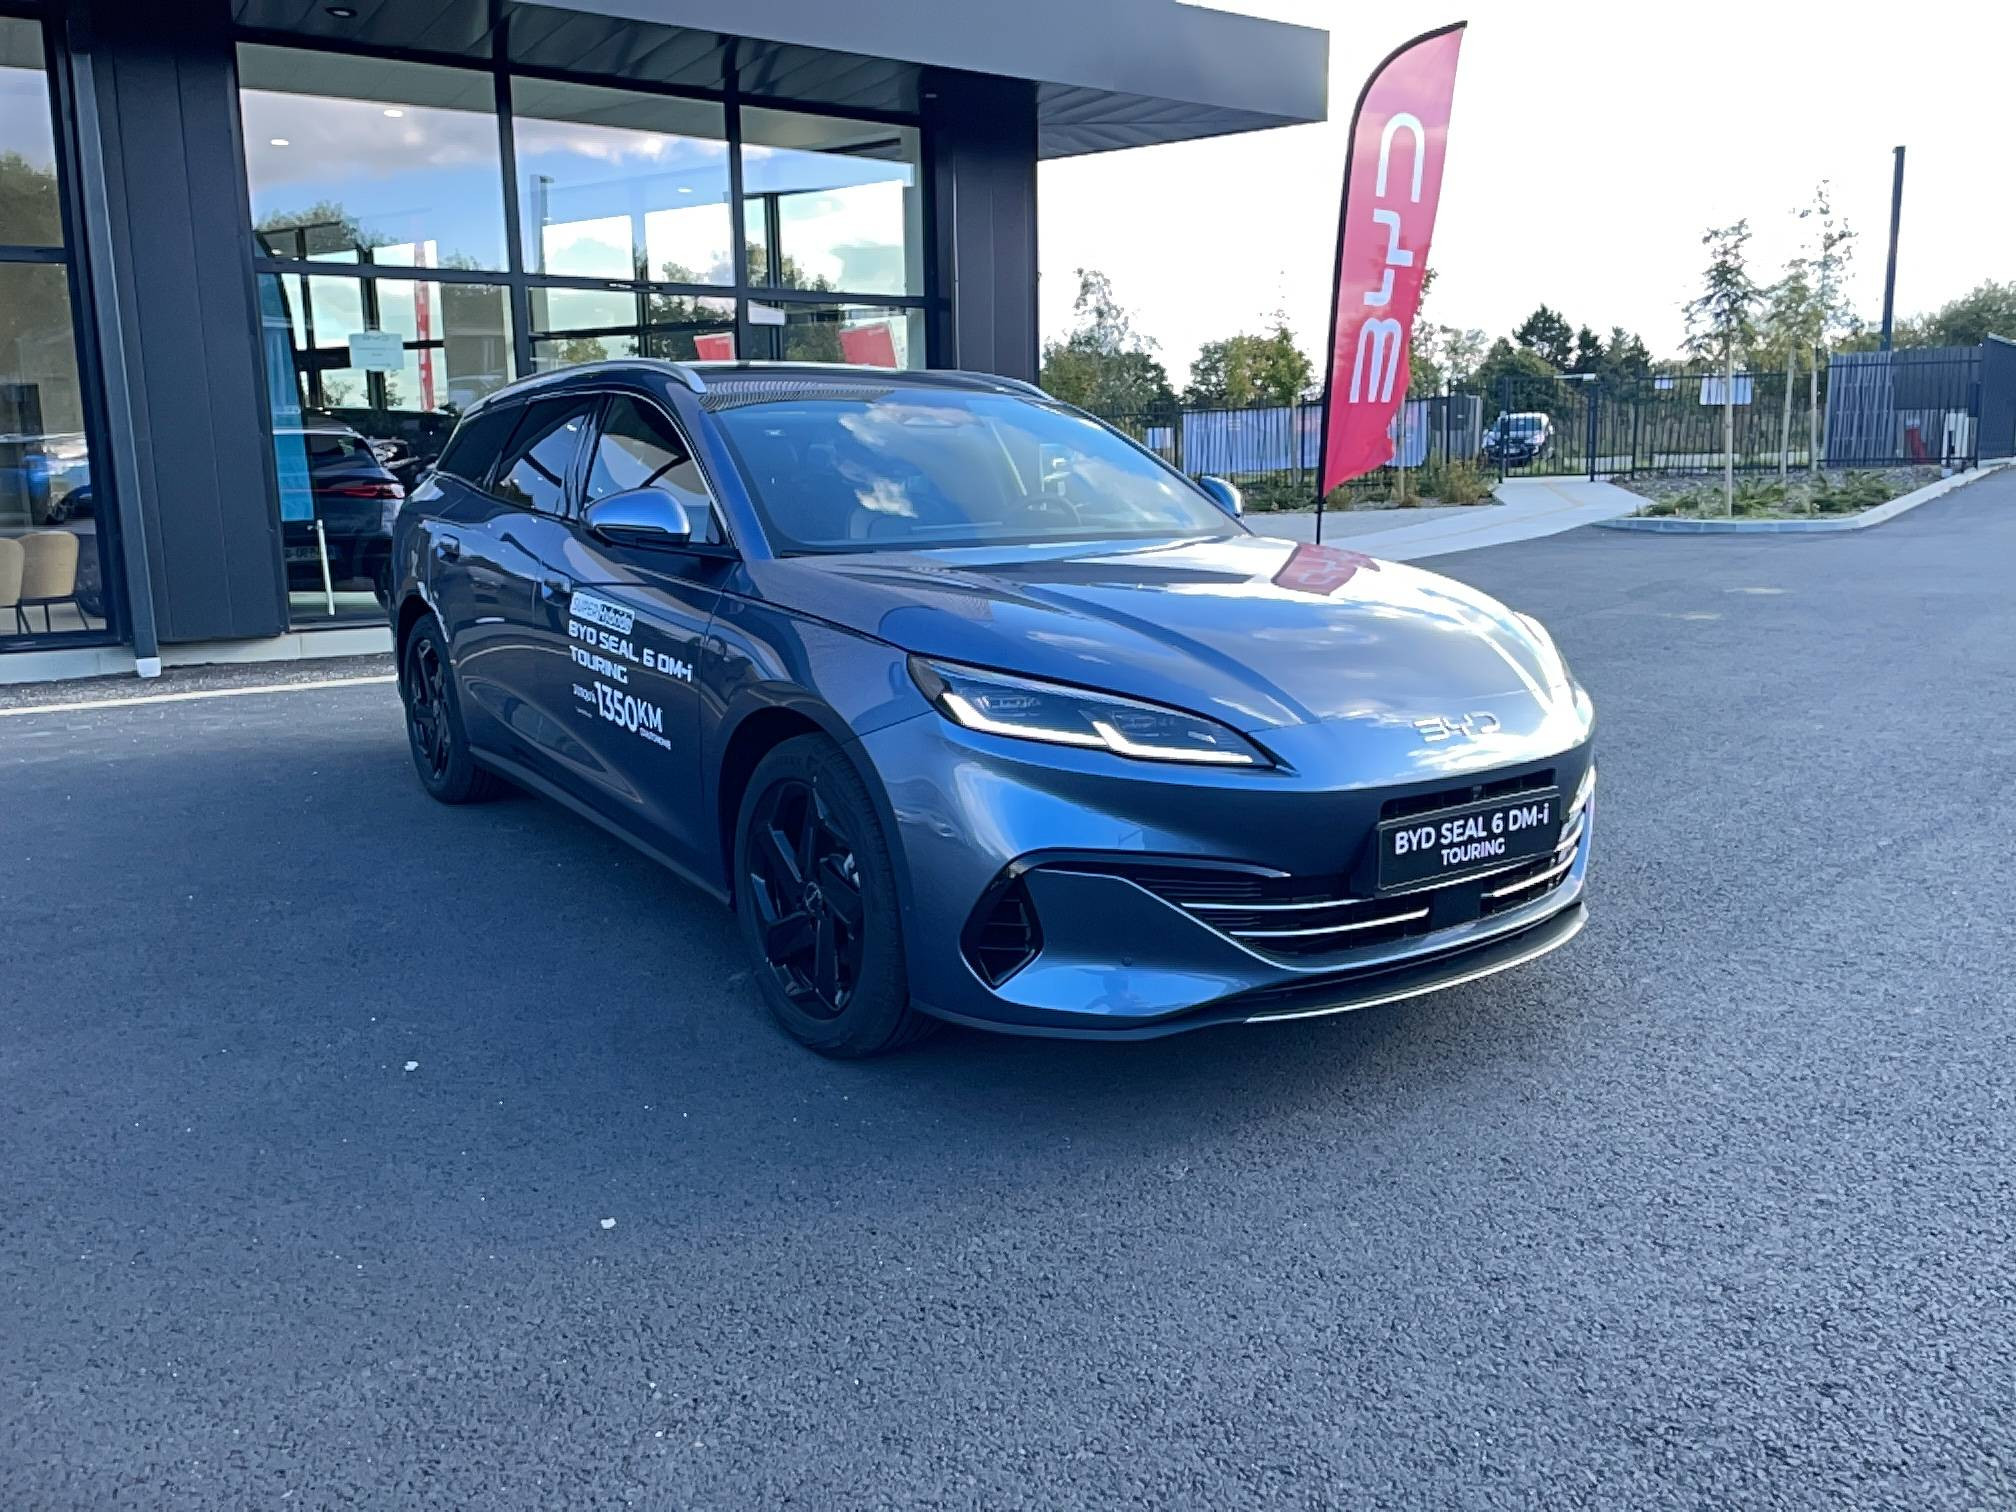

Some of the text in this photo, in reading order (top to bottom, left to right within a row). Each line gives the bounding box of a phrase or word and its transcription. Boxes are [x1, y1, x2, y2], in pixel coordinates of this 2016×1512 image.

[1348, 112, 1426, 404] BYD
[569, 619, 694, 683] BYD SEAL 6 DM-i
[569, 645, 628, 684] TOURING
[1413, 711, 1501, 743] BYD
[1395, 803, 1550, 855] BYD SEAL 6 DM-i
[1441, 838, 1506, 866] TOURING
